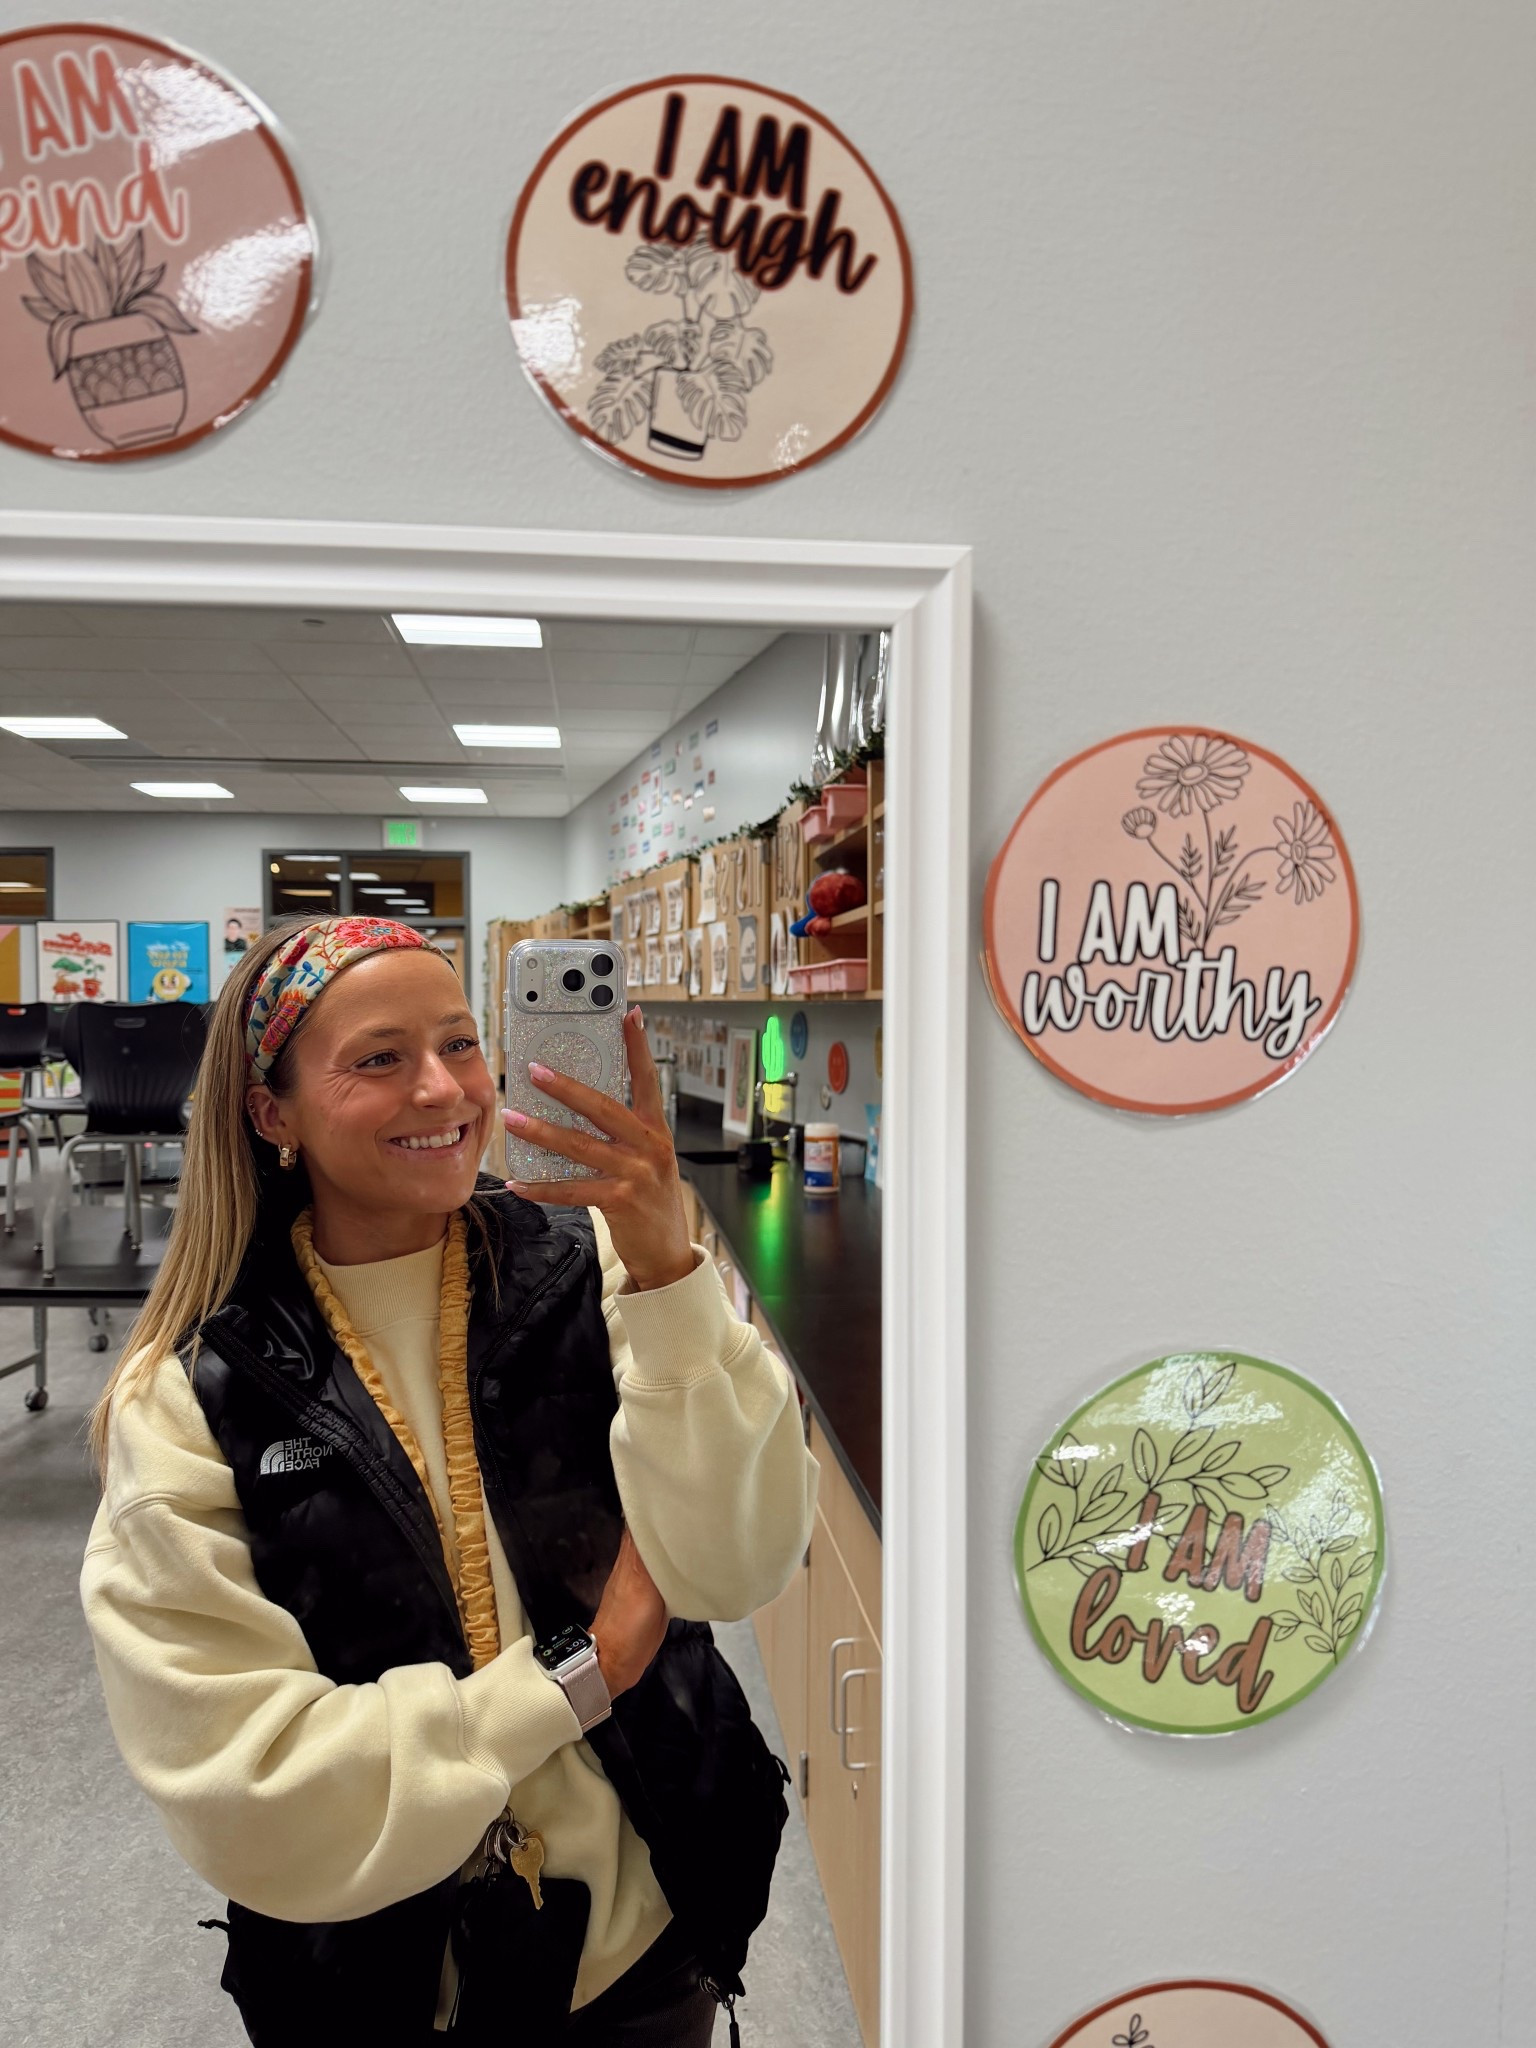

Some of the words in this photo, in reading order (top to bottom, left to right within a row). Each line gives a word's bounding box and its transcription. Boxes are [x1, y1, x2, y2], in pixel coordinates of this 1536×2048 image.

[15, 48, 142, 160] AM
[654, 91, 686, 180] I
[695, 104, 811, 210] AM
[569, 160, 878, 294] enough
[1038, 878, 1060, 963] I
[1077, 880, 1182, 966] AM
[1022, 945, 1322, 1059] worthy
[1126, 1491, 1162, 1572] I
[1163, 1503, 1273, 1602] AM
[1070, 1566, 1274, 1714] loved
